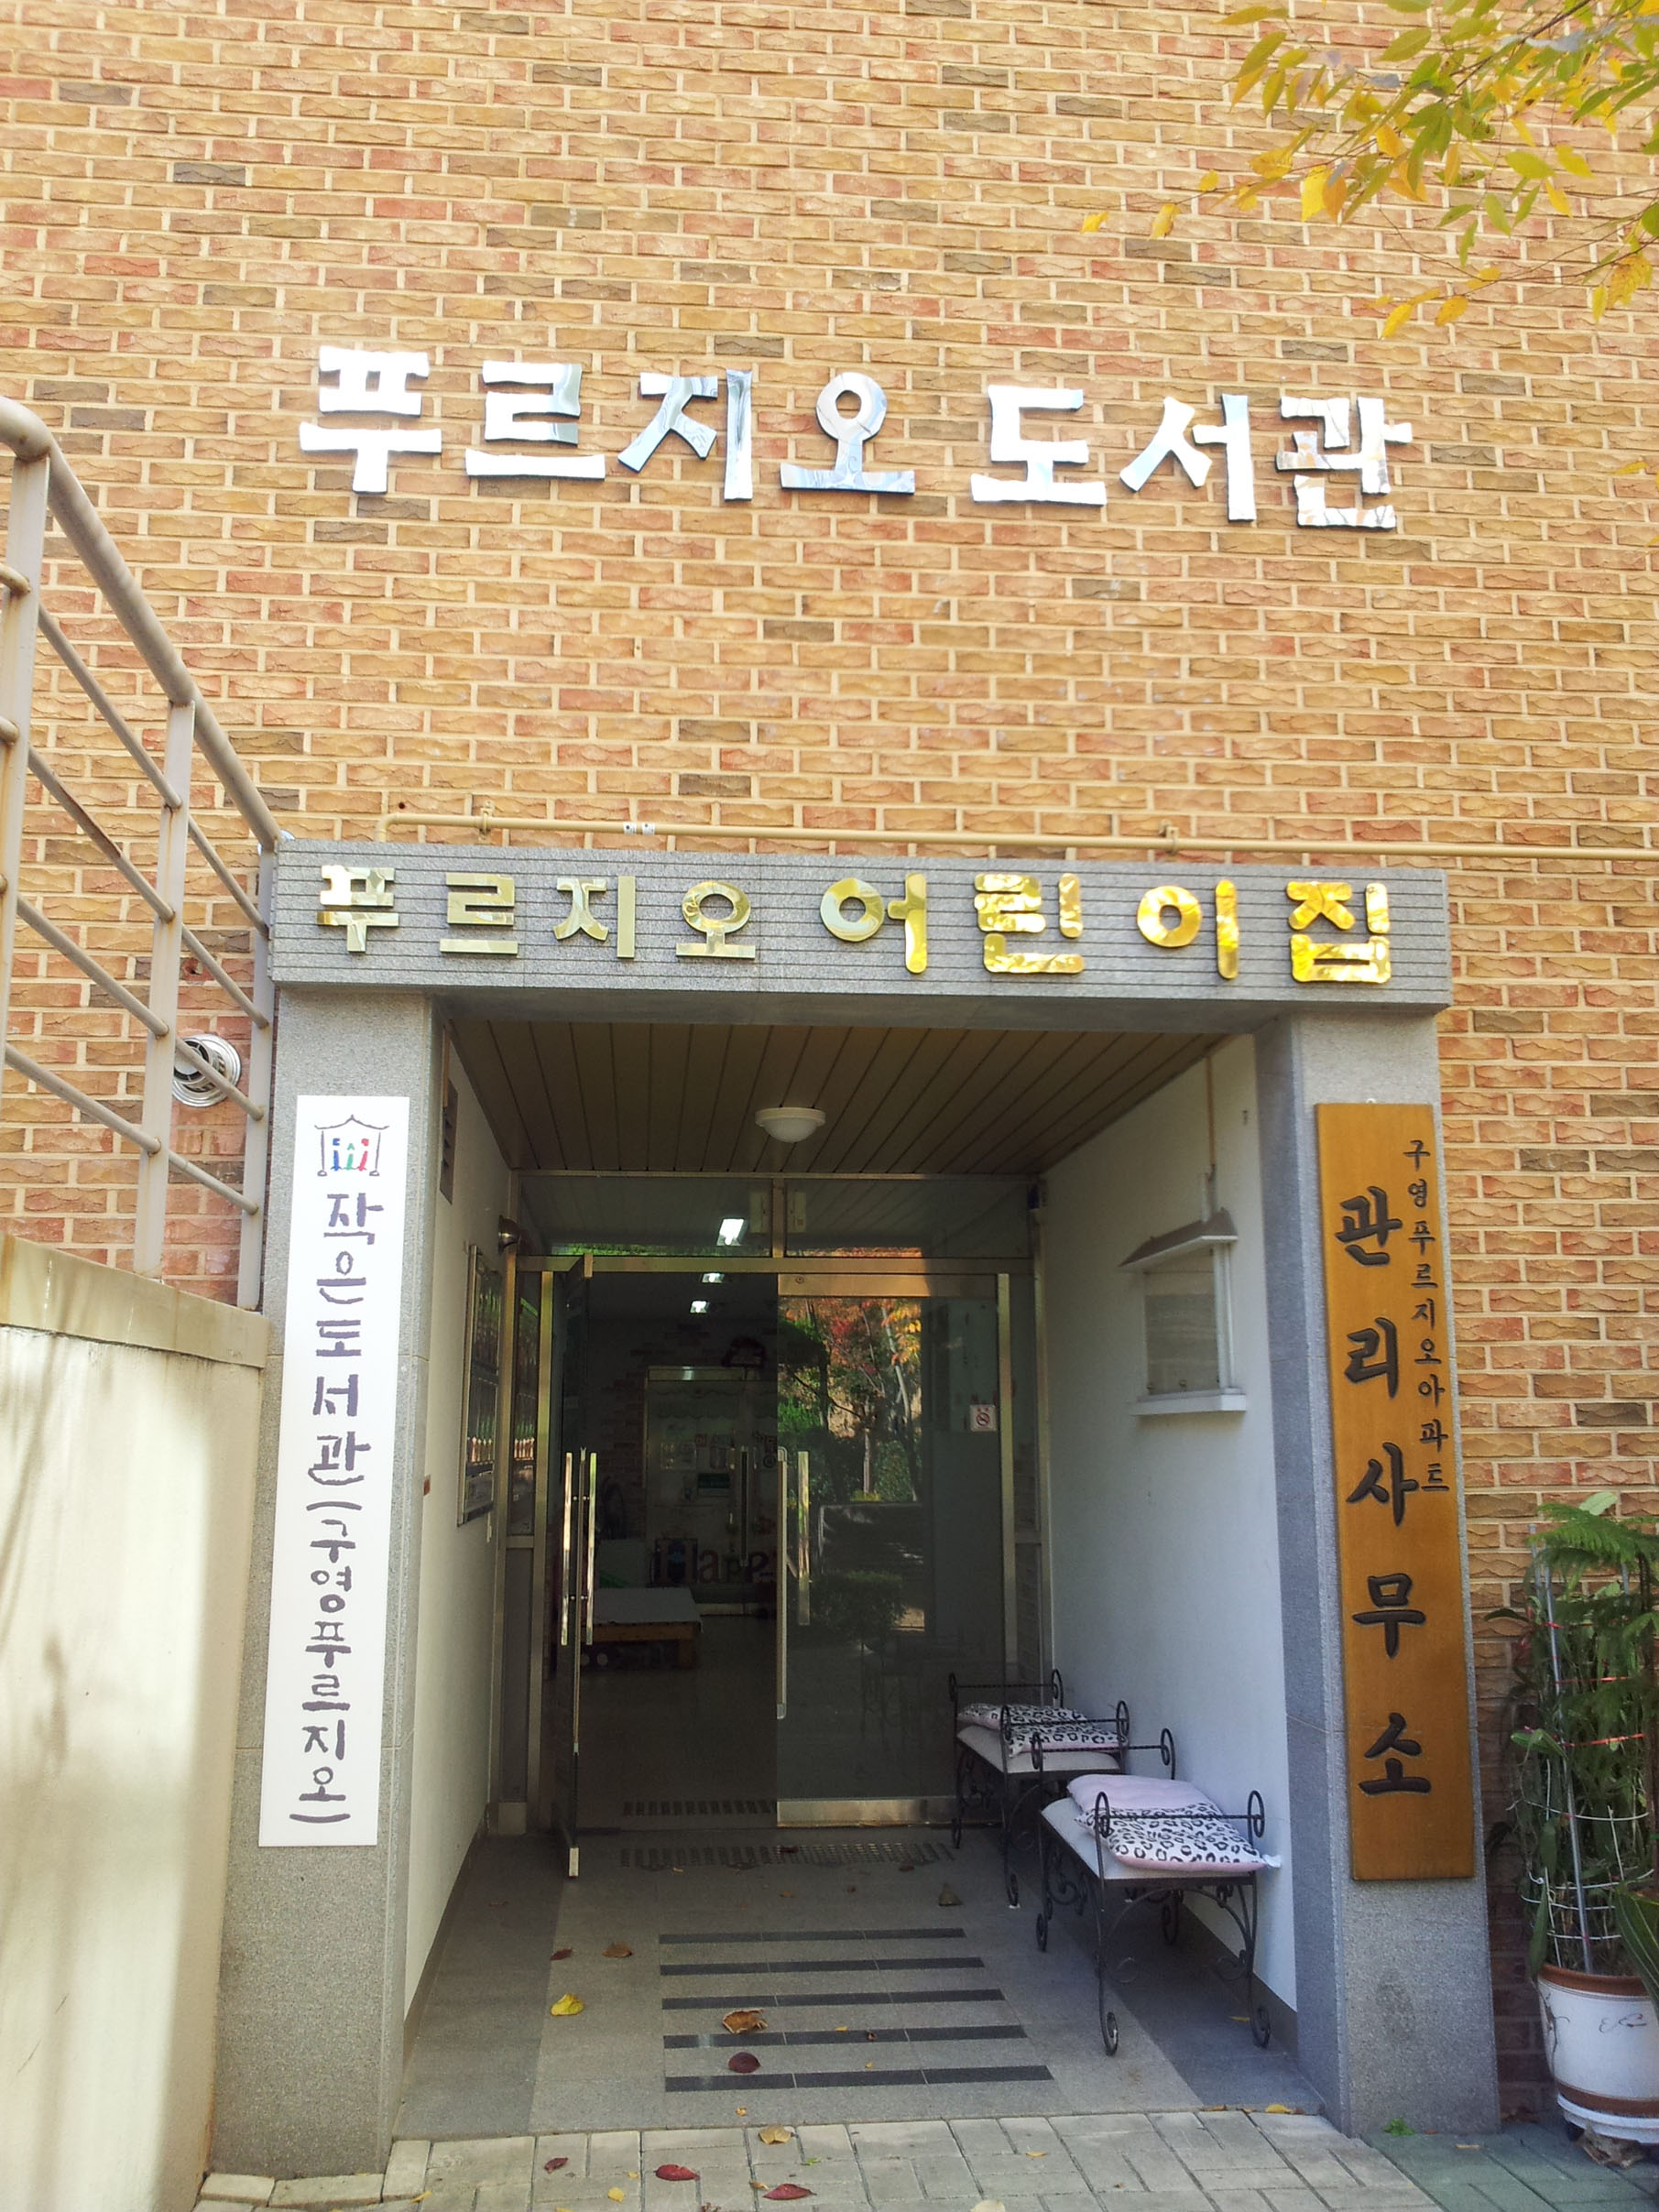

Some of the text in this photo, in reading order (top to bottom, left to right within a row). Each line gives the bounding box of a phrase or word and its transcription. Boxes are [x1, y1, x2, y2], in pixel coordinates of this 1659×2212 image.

[299, 345, 1414, 529] 푸르지오 도서관
[317, 863, 1392, 985] 푸르지오 어린이집
[1402, 1139, 1450, 1492] 구영푸르지오아파트
[1334, 1185, 1432, 1796] 관리사무소
